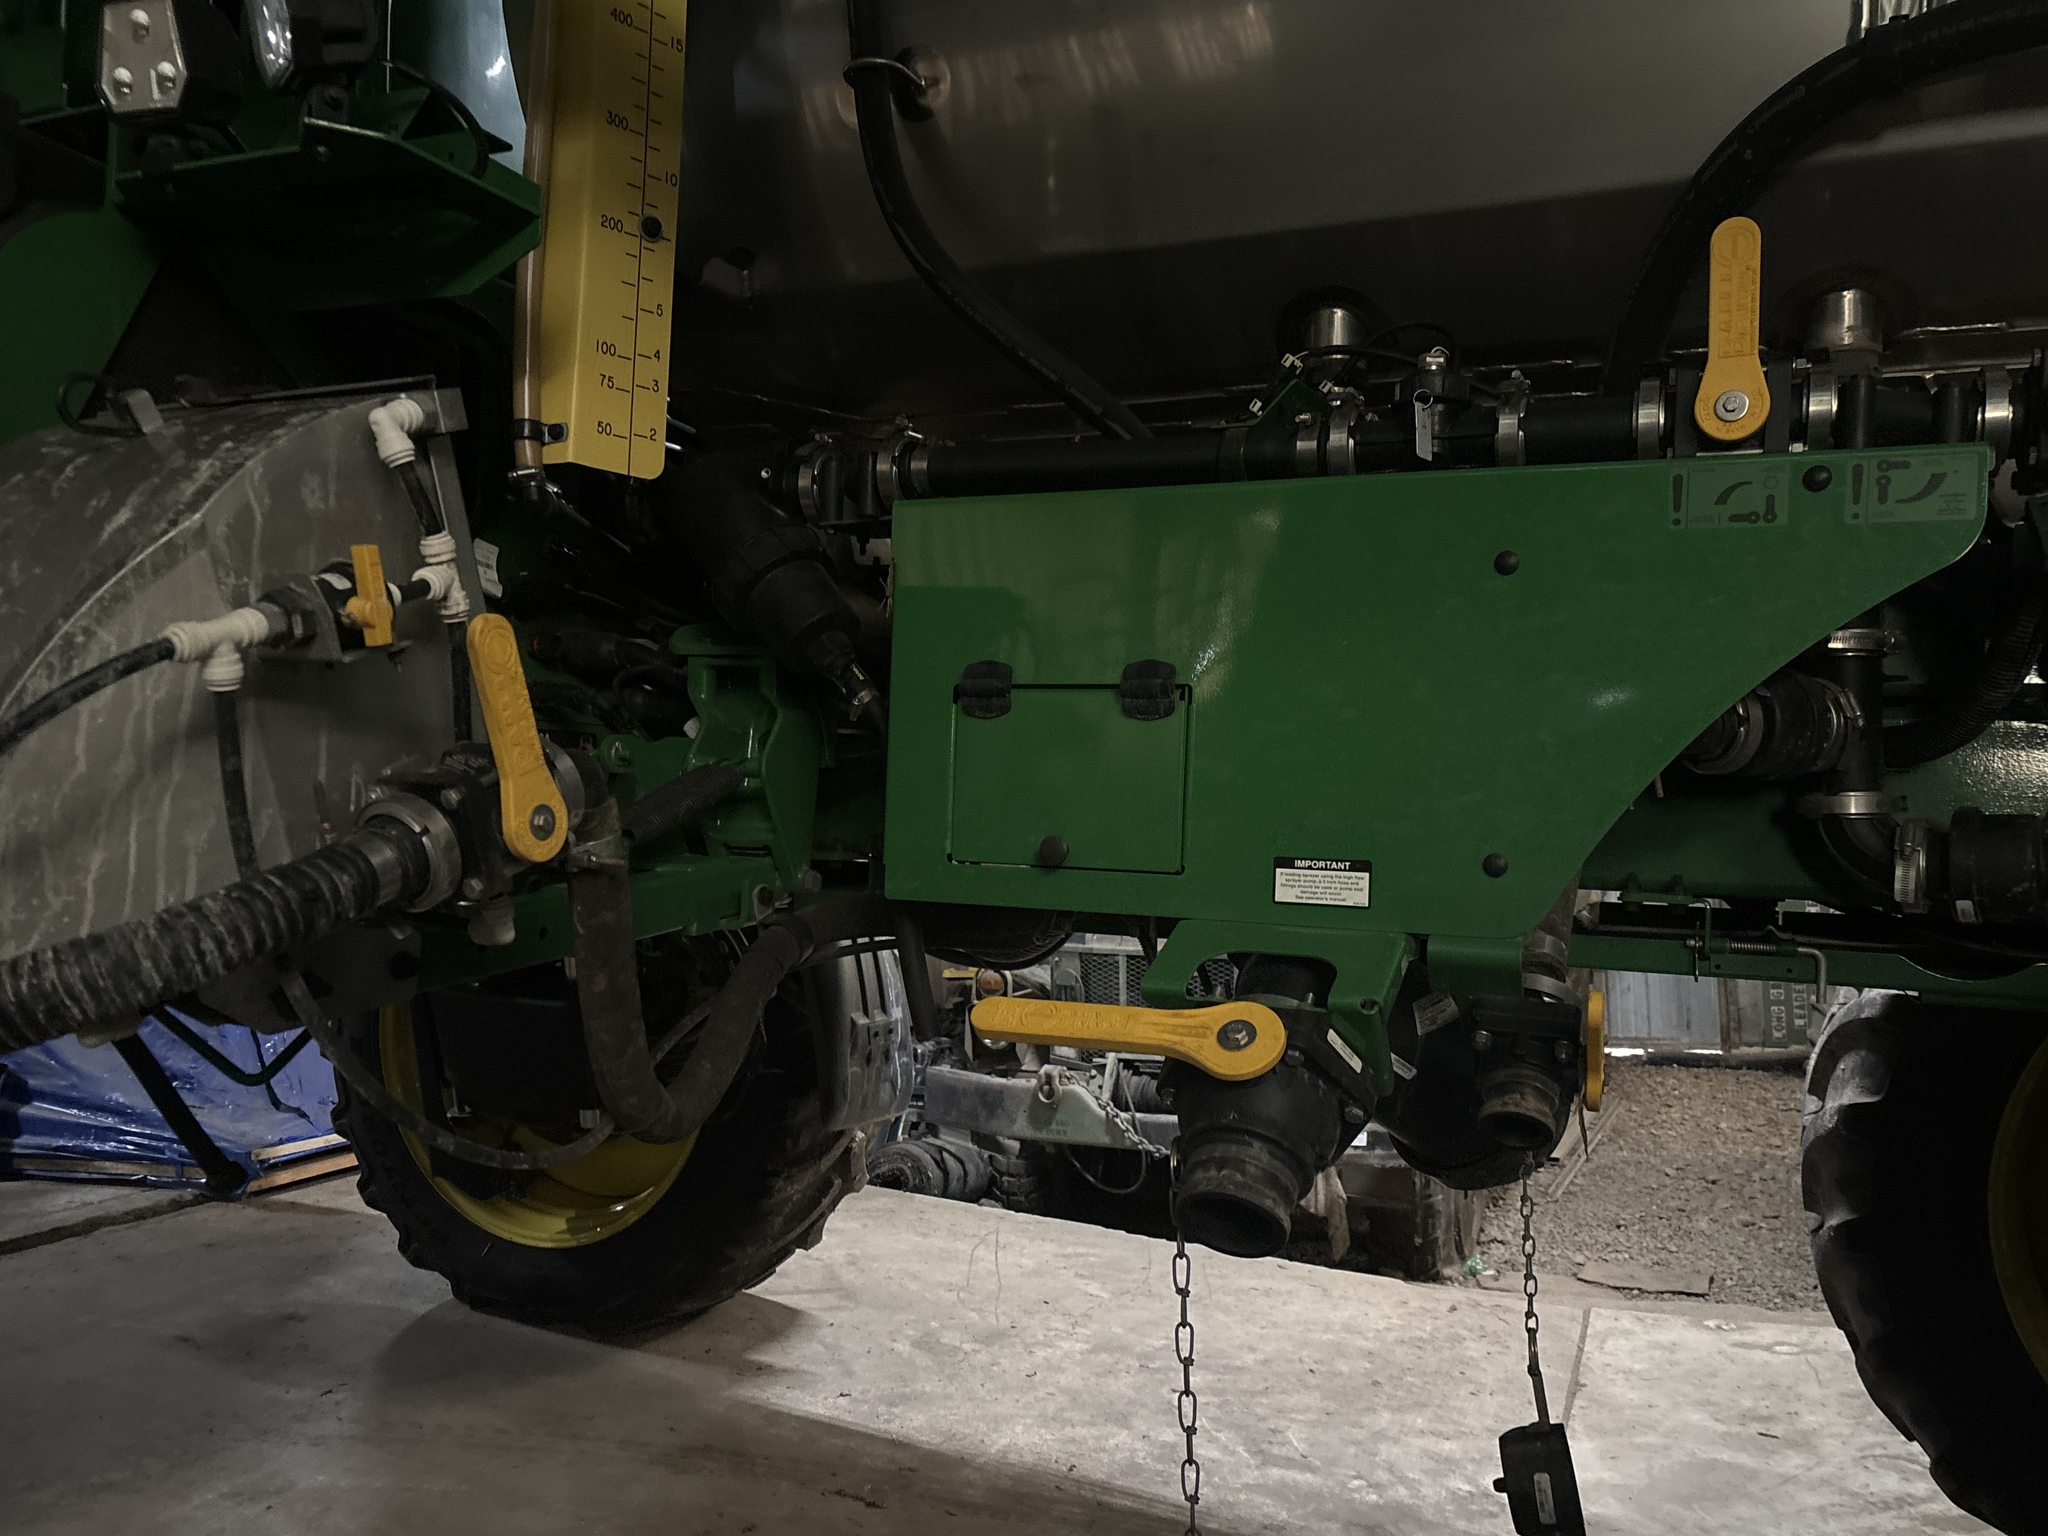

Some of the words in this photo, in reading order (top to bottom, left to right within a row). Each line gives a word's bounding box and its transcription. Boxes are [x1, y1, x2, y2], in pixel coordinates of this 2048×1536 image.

[610, 7, 634, 27] 400
[671, 37, 684, 53] 15
[606, 110, 629, 131] 300
[664, 172, 678, 187] 10
[601, 215, 624, 233] 200
[656, 304, 664, 317] 5
[596, 339, 617, 357] 100
[653, 349, 661, 363] 4
[599, 374, 615, 389] 75
[652, 380, 660, 393] 3
[597, 421, 612, 437] 50
[649, 428, 657, 442] 2
[1294, 860, 1351, 870] IMPORTANT
